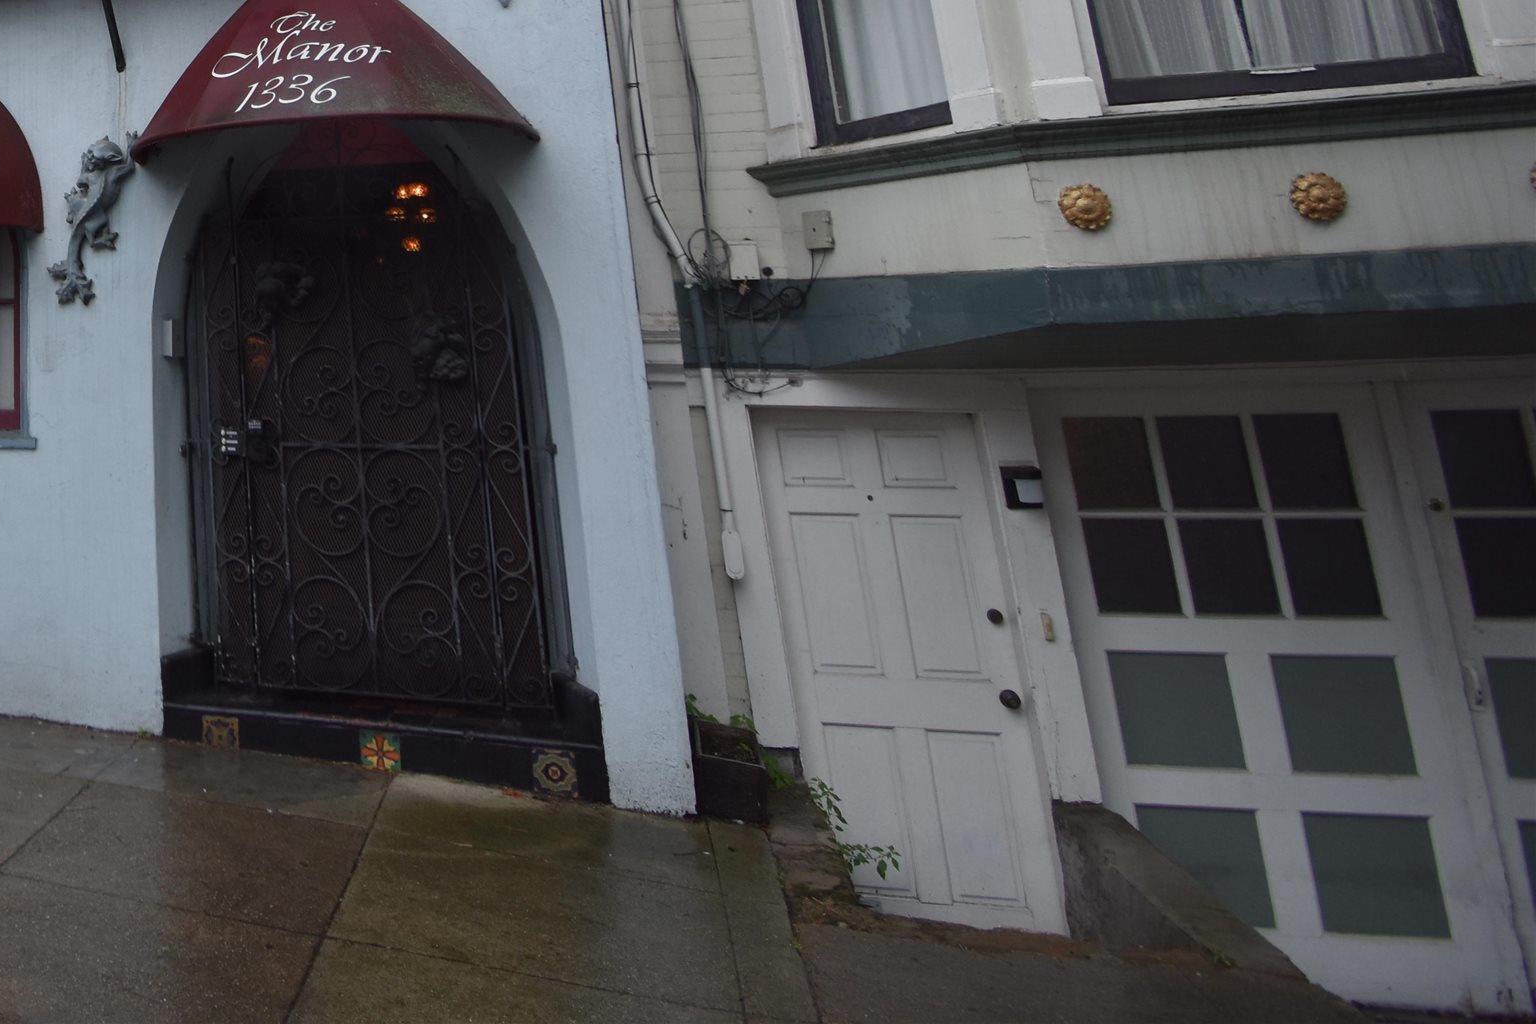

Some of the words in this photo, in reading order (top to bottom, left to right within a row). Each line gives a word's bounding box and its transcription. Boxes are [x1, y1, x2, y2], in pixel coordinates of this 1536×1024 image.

[270, 11, 337, 34] The
[211, 30, 392, 78] Manor
[235, 74, 352, 113] 1336
